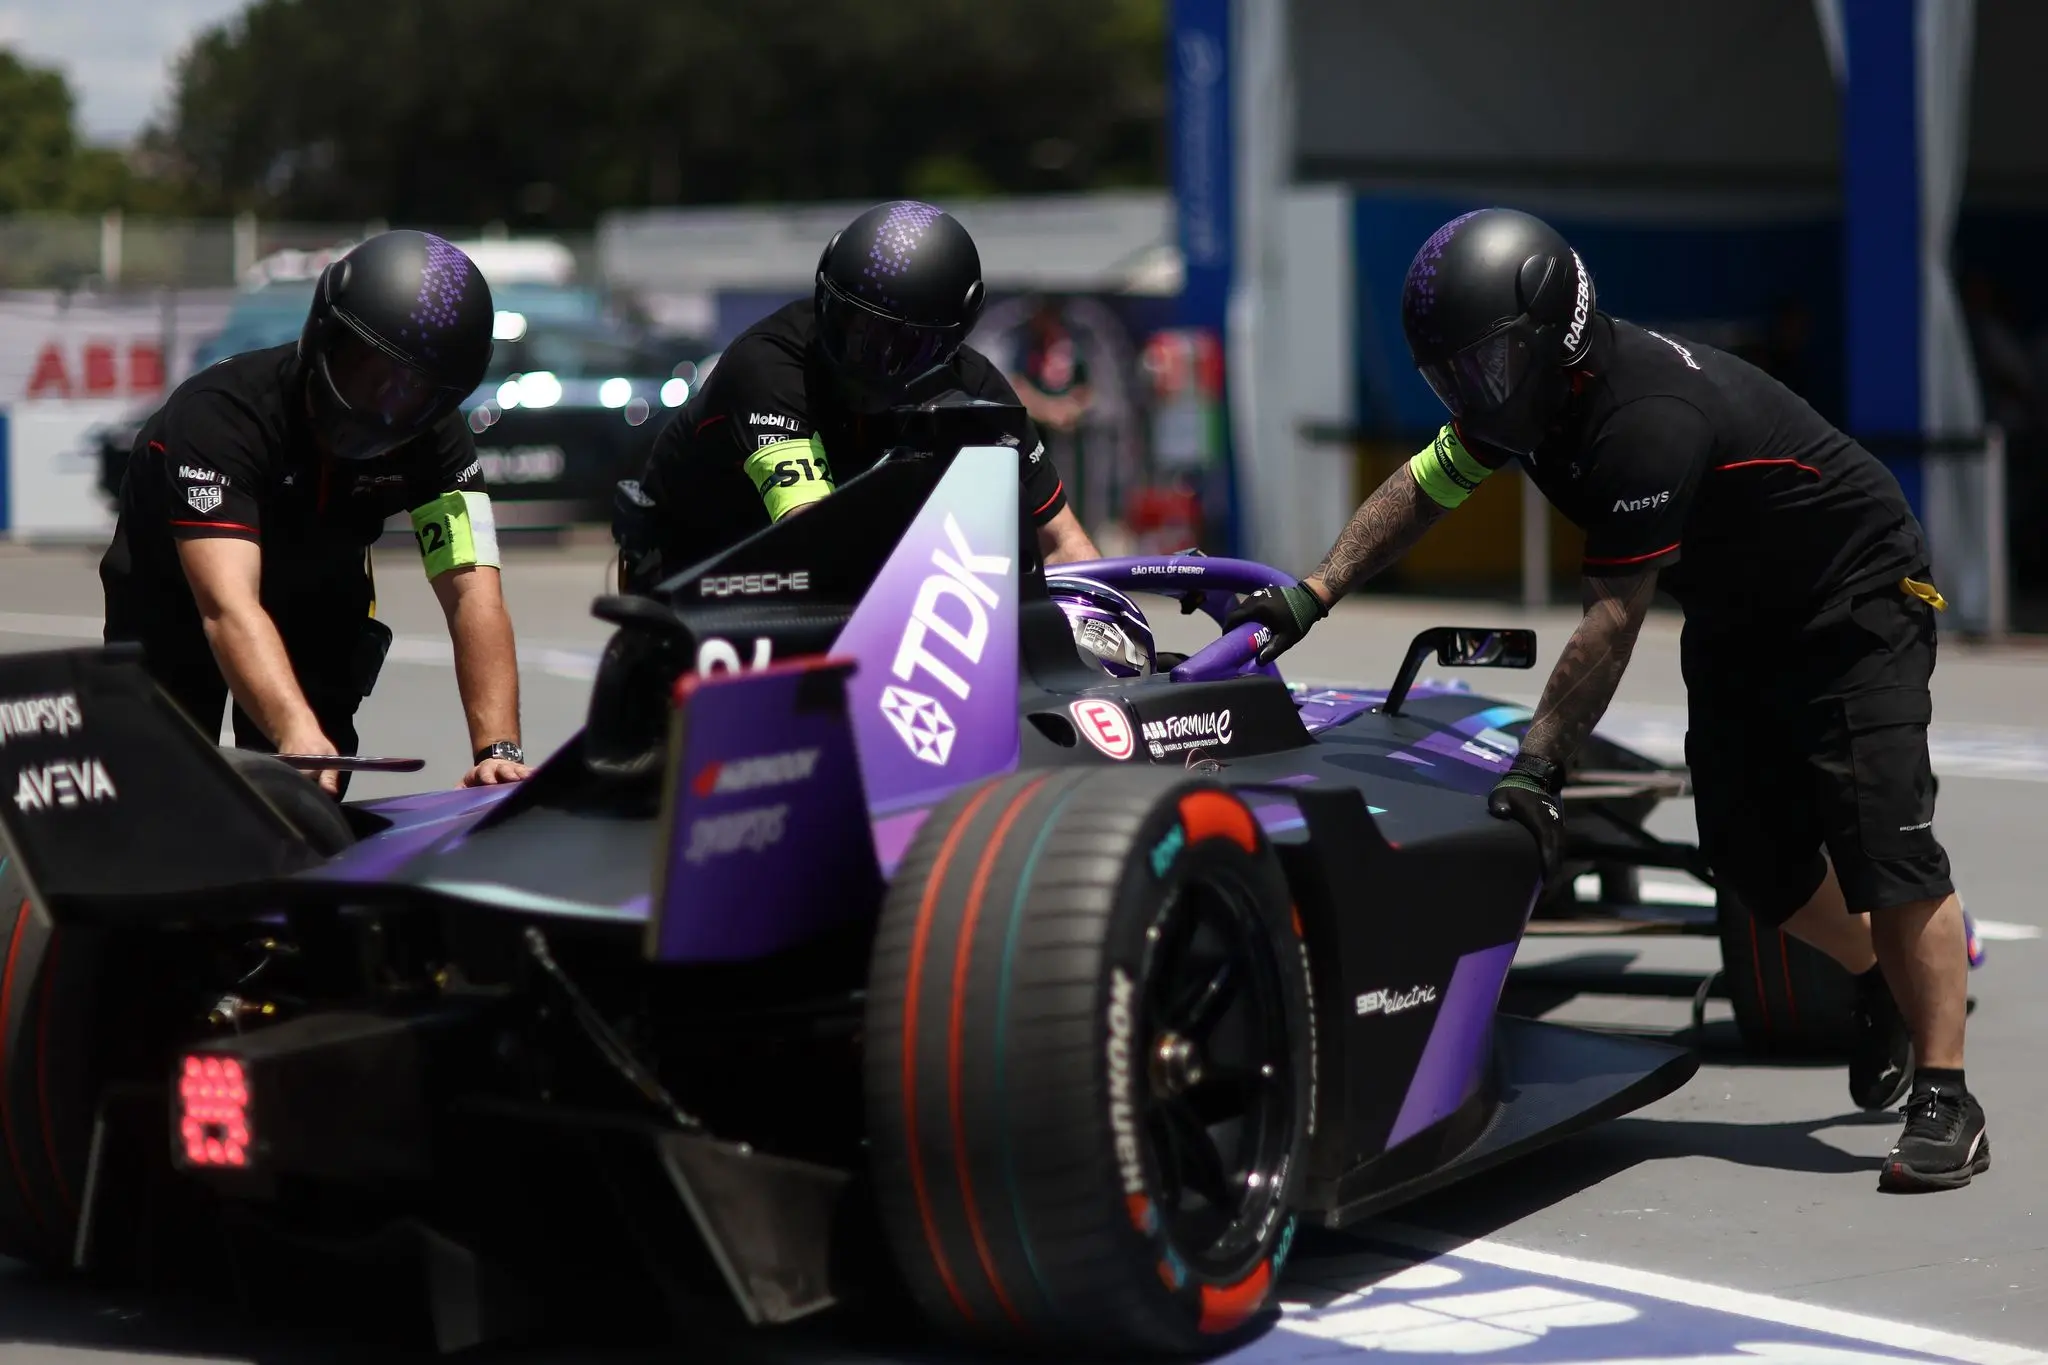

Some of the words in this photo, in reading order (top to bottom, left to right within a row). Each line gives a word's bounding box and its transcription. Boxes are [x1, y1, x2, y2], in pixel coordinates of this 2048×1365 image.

[749, 412, 785, 427] Mobil
[178, 465, 215, 482] Mobil
[775, 458, 834, 488] S12
[190, 487, 218, 497] TAG
[1612, 490, 1670, 513] Ansys
[190, 497, 219, 511] HEUER
[1131, 565, 1147, 575] SÃO
[1148, 566, 1166, 574] FULL
[1167, 565, 1177, 574] OF
[1177, 565, 1206, 575] ENERGY
[700, 571, 810, 597] PORSCHE
[891, 510, 1012, 701] TDK
[1141, 720, 1168, 741] ABB
[1165, 711, 1217, 740] FORMULA
[1164, 743, 1183, 752] WORLD
[1182, 738, 1219, 749] CHAMPIONSHIP
[13, 758, 117, 812] AVEVA
